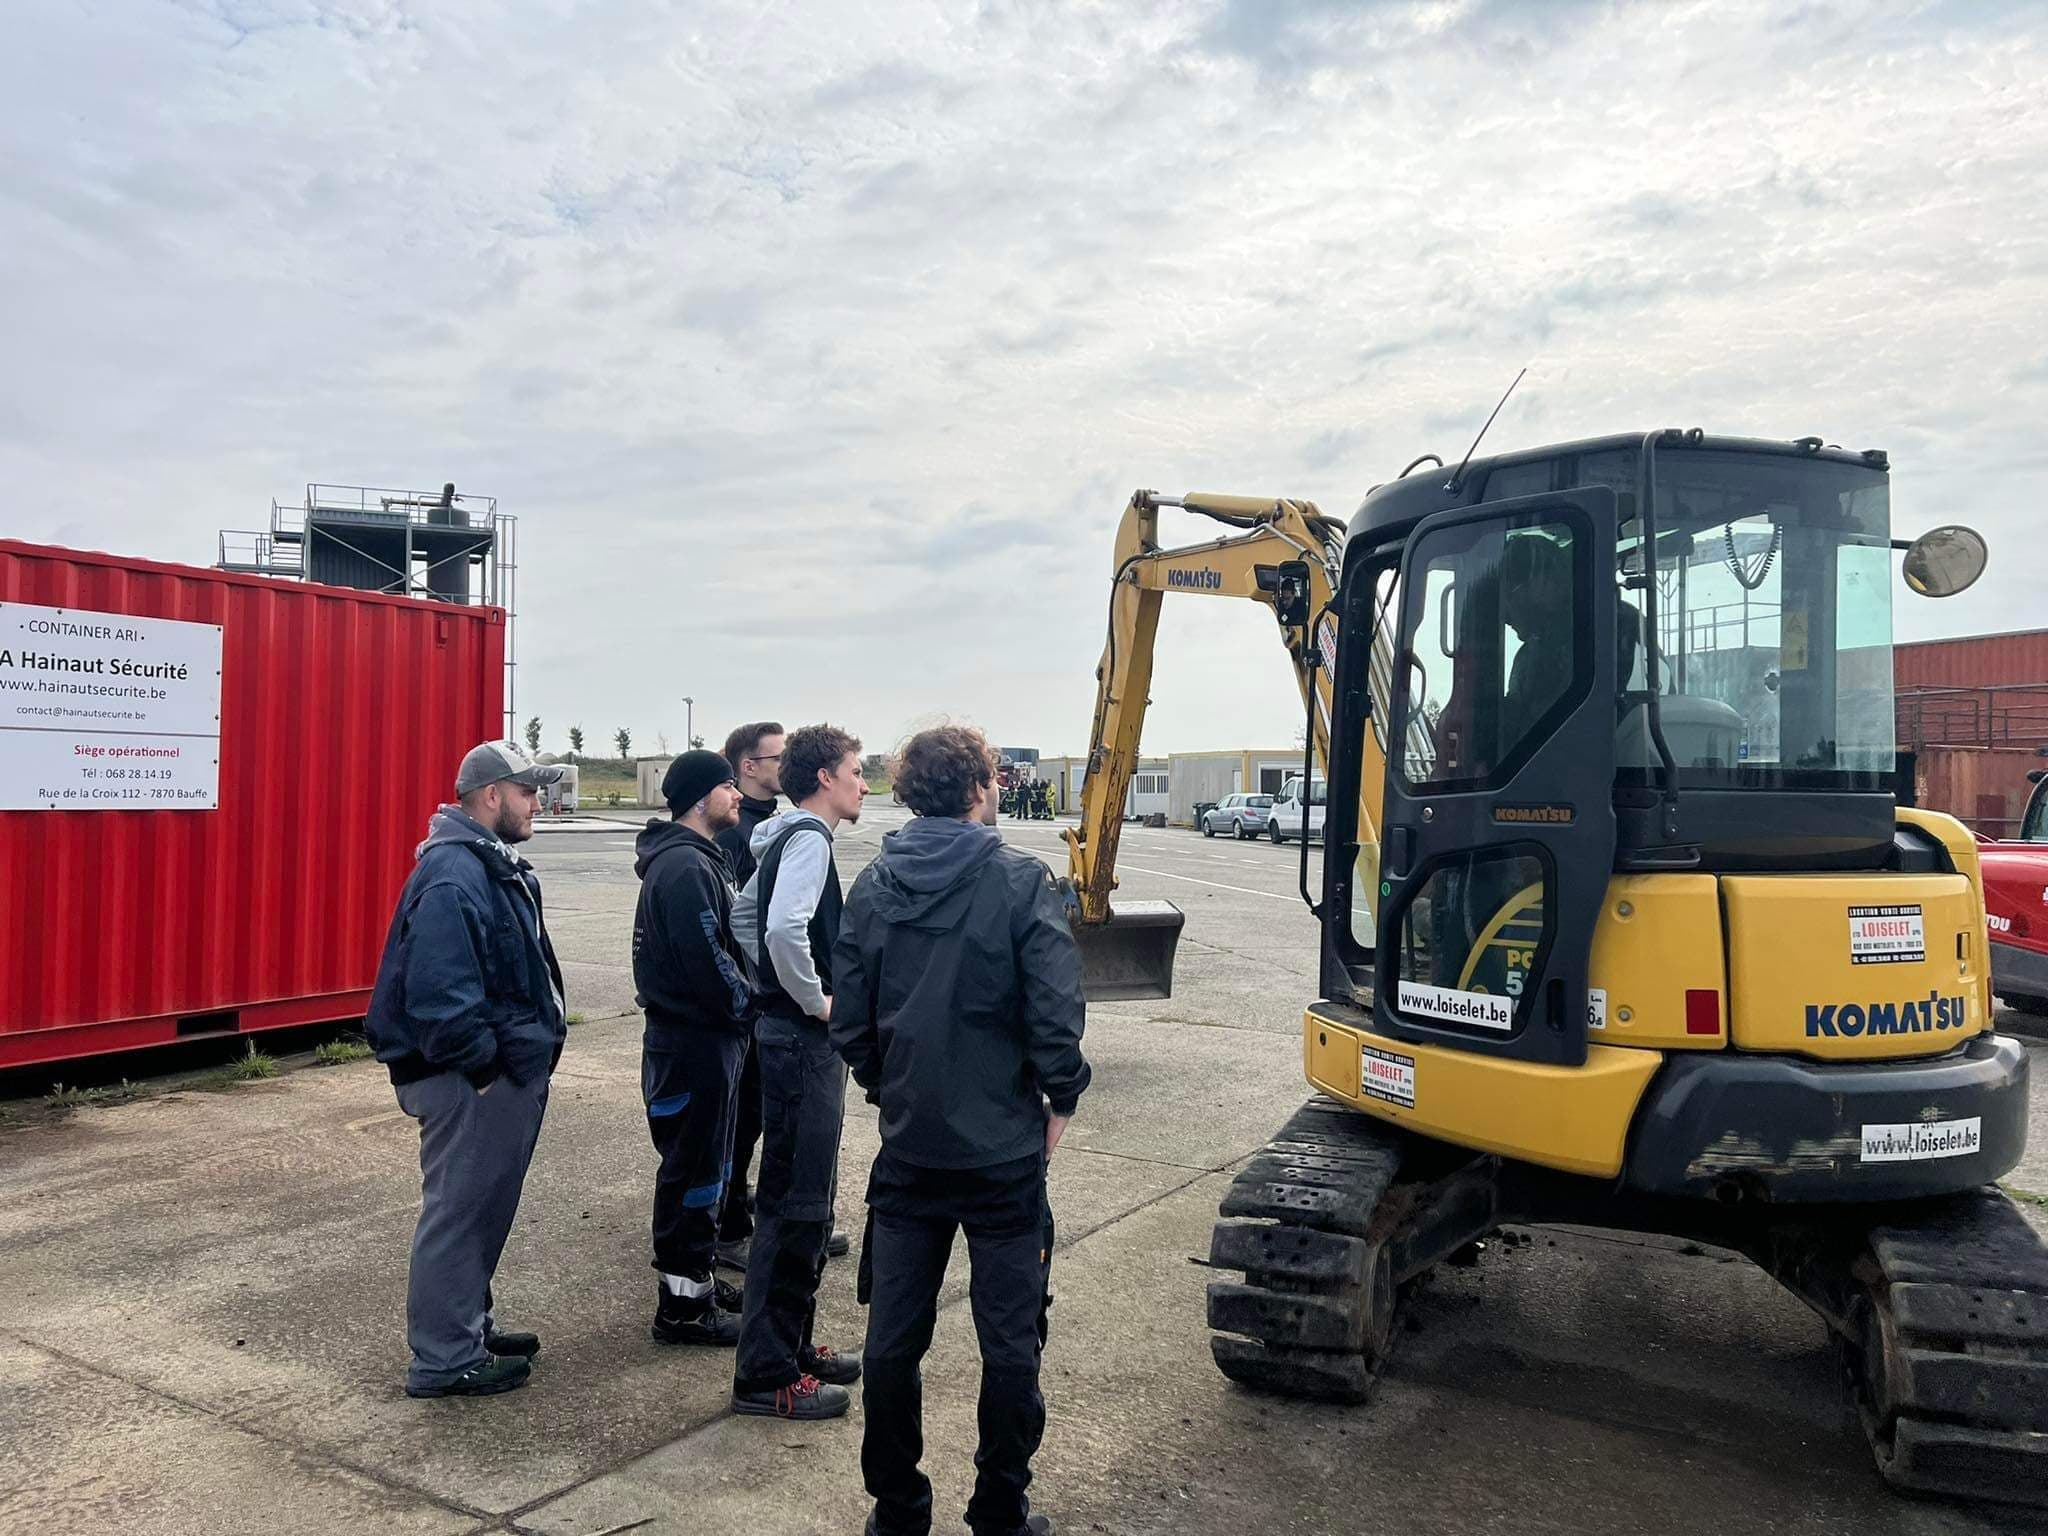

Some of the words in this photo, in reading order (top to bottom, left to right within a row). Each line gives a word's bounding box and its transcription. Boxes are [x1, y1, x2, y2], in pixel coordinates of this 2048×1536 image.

[1168, 566, 1221, 589] KOMATSU
[29, 620, 111, 639] CONTAINER
[115, 629, 137, 641] ARI
[21, 651, 103, 674] Hainaut
[110, 659, 187, 680] Sécurité
[17, 706, 146, 720] contact@hainautsecurite.be
[74, 745, 105, 758] Siège
[108, 746, 180, 758] opérationnel
[81, 768, 97, 779] Tél
[105, 769, 125, 779] 068
[128, 769, 172, 779] 28.14.19
[39, 788, 60, 799] Rue
[63, 788, 77, 798] de
[80, 788, 89, 798] la
[92, 788, 118, 799] Croix
[122, 789, 140, 798] 112
[150, 788, 175, 798] 7870
[177, 788, 208, 799] Bauffe
[1495, 806, 1571, 821] KOMATSU
[1862, 921, 1910, 937] LOISELET
[1401, 994, 1508, 1022] www.loiselet.be
[1805, 990, 1964, 1037] KOMATSU
[1368, 1060, 1402, 1082] LOISELET
[1865, 1126, 1978, 1154] www.loiselet.be
